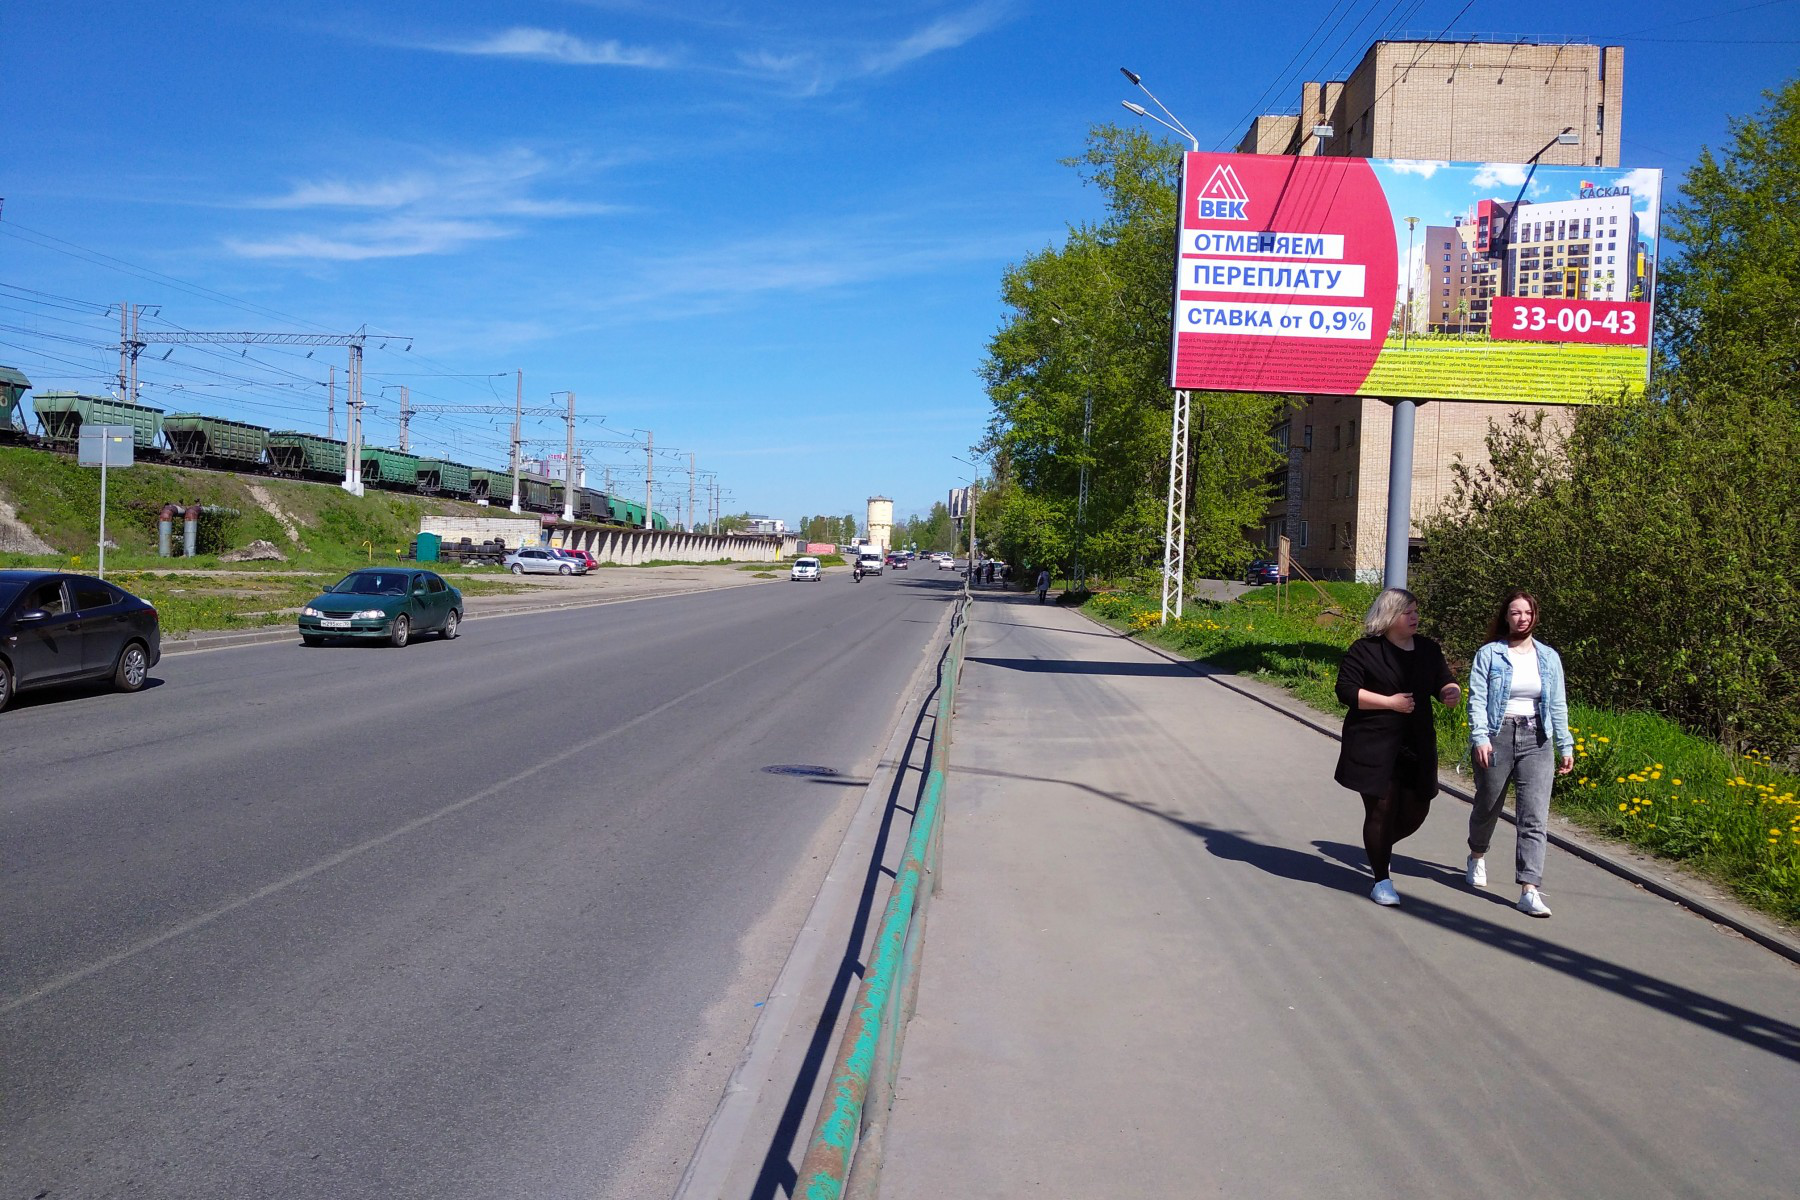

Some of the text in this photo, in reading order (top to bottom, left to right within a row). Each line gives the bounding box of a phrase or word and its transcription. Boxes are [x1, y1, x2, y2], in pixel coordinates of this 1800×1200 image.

[1579, 186, 1630, 199] КАСКАД
[1200, 200, 1246, 219] ВЕК
[1194, 233, 1324, 255] ОТМЕНЯЕМ
[1194, 265, 1342, 290] ПЕРЕПЛАТУ
[1187, 307, 1366, 333] СТАВКА от 0,9%
[1512, 306, 1636, 335] 33-00-43
